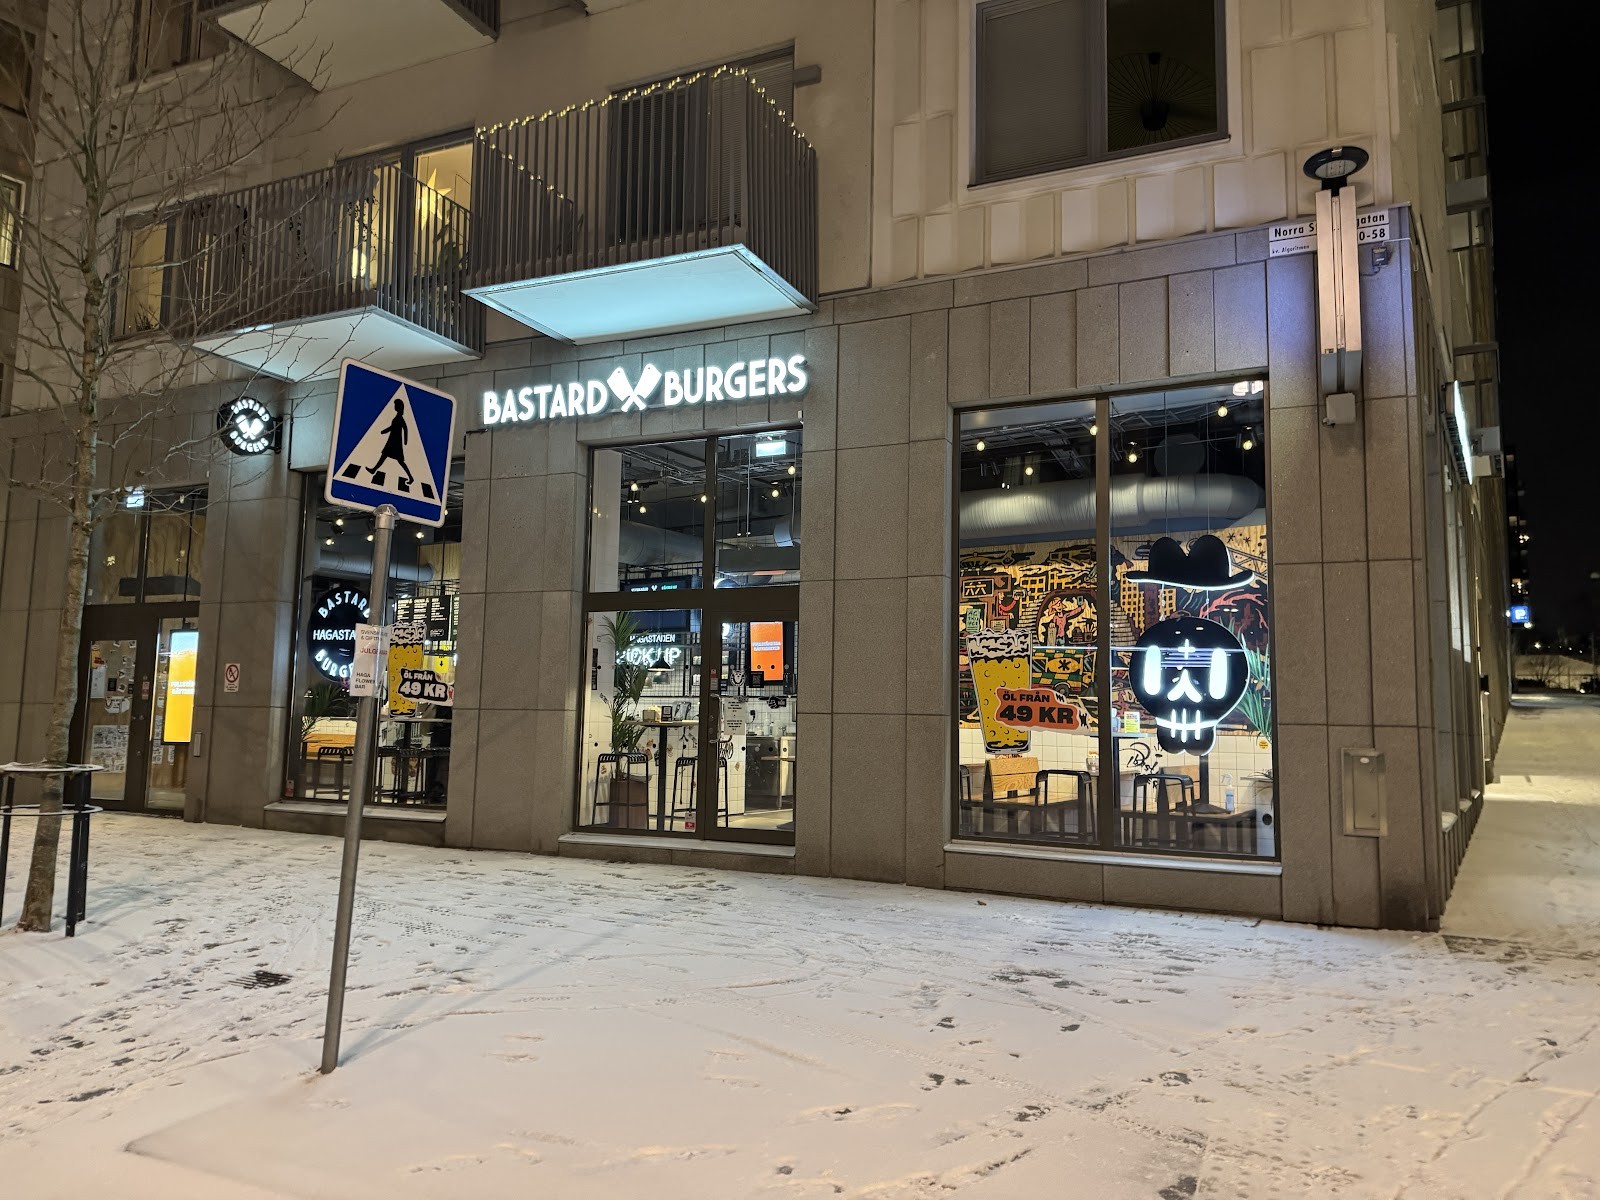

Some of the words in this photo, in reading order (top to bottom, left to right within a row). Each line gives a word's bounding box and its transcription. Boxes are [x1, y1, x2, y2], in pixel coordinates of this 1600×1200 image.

[1274, 226, 1304, 238] Norra
[1357, 228, 1386, 241] 0-58
[483, 379, 608, 425] BASTARD
[664, 354, 807, 407] BURGERS
[230, 399, 270, 422] BASTARD
[230, 430, 269, 453] BURGERS
[313, 629, 356, 641] HAGASTA
[403, 671, 413, 680] ÖL
[413, 671, 434, 681] FRÅN
[400, 681, 422, 696] 49
[423, 682, 446, 699] KR
[1002, 691, 1017, 702] ÖL
[1019, 690, 1051, 703] FRÅN
[999, 705, 1033, 723] 49
[1038, 706, 1074, 725] KR
